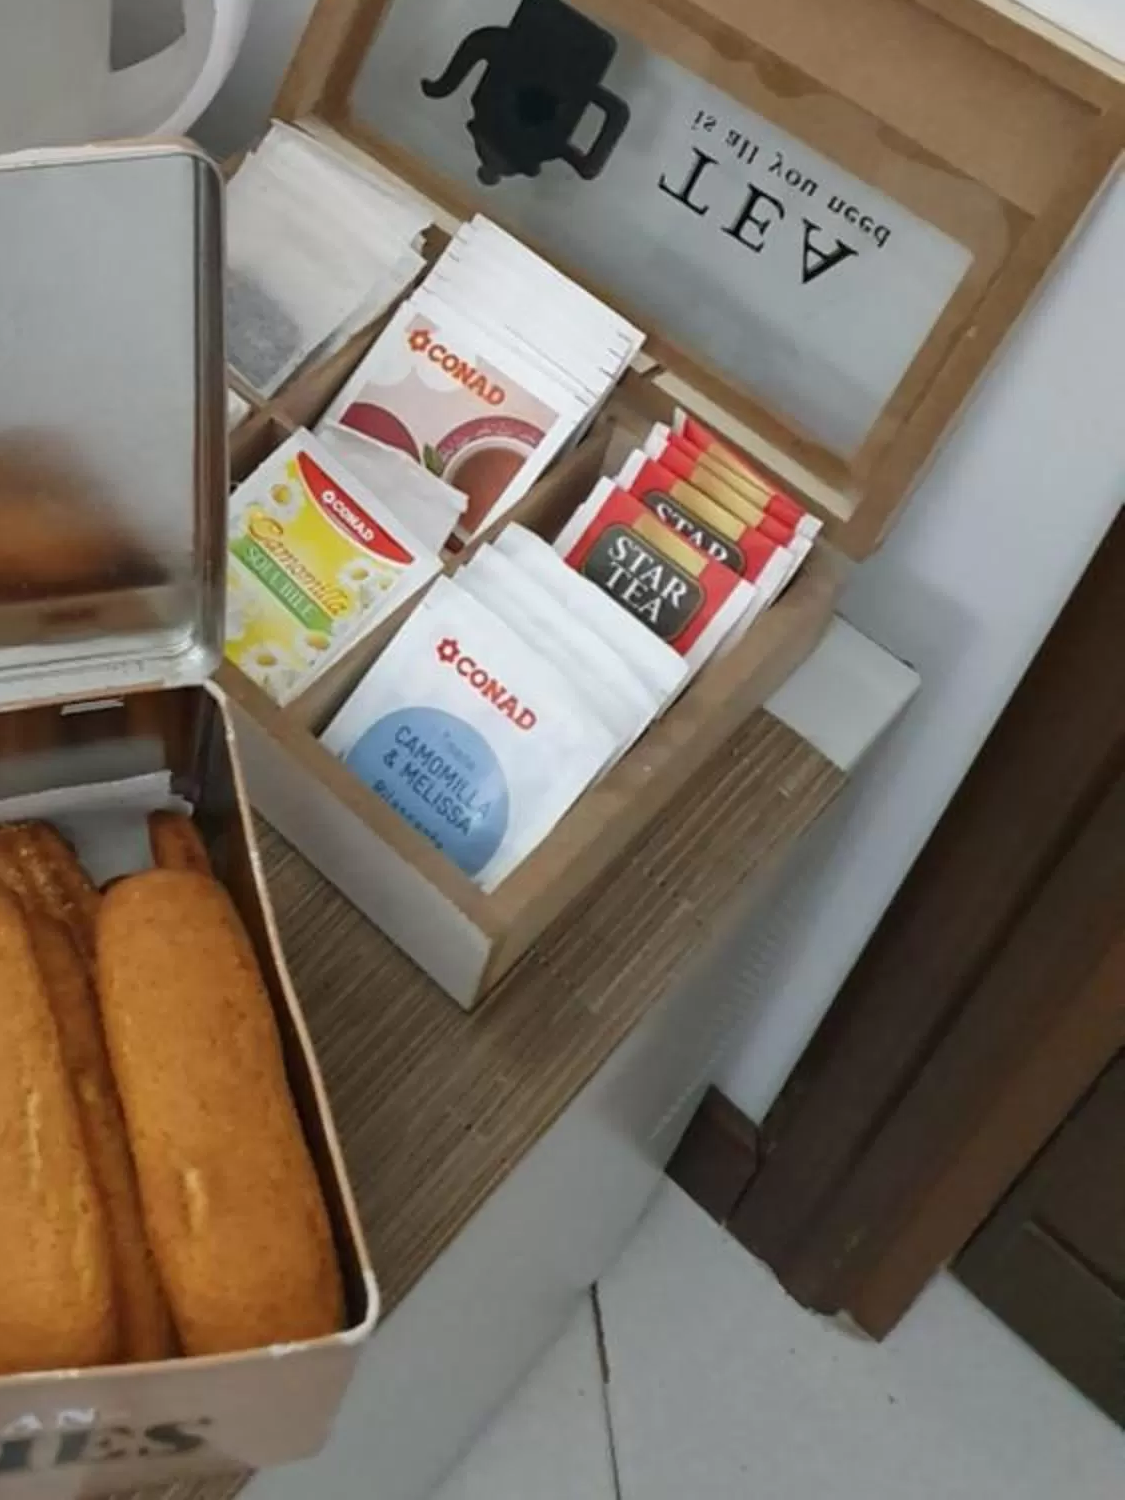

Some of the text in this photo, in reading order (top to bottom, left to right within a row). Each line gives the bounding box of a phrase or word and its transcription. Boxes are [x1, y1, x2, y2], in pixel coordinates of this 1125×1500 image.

[427, 343, 506, 406] CONAD
[332, 500, 375, 542] CONAD
[605, 560, 663, 624] TEA
[606, 535, 688, 609] STAR
[455, 656, 538, 731] CONAD
[382, 749, 400, 769] &
[399, 761, 475, 836] MELISSA
[393, 724, 493, 821] CAMOMILLA
